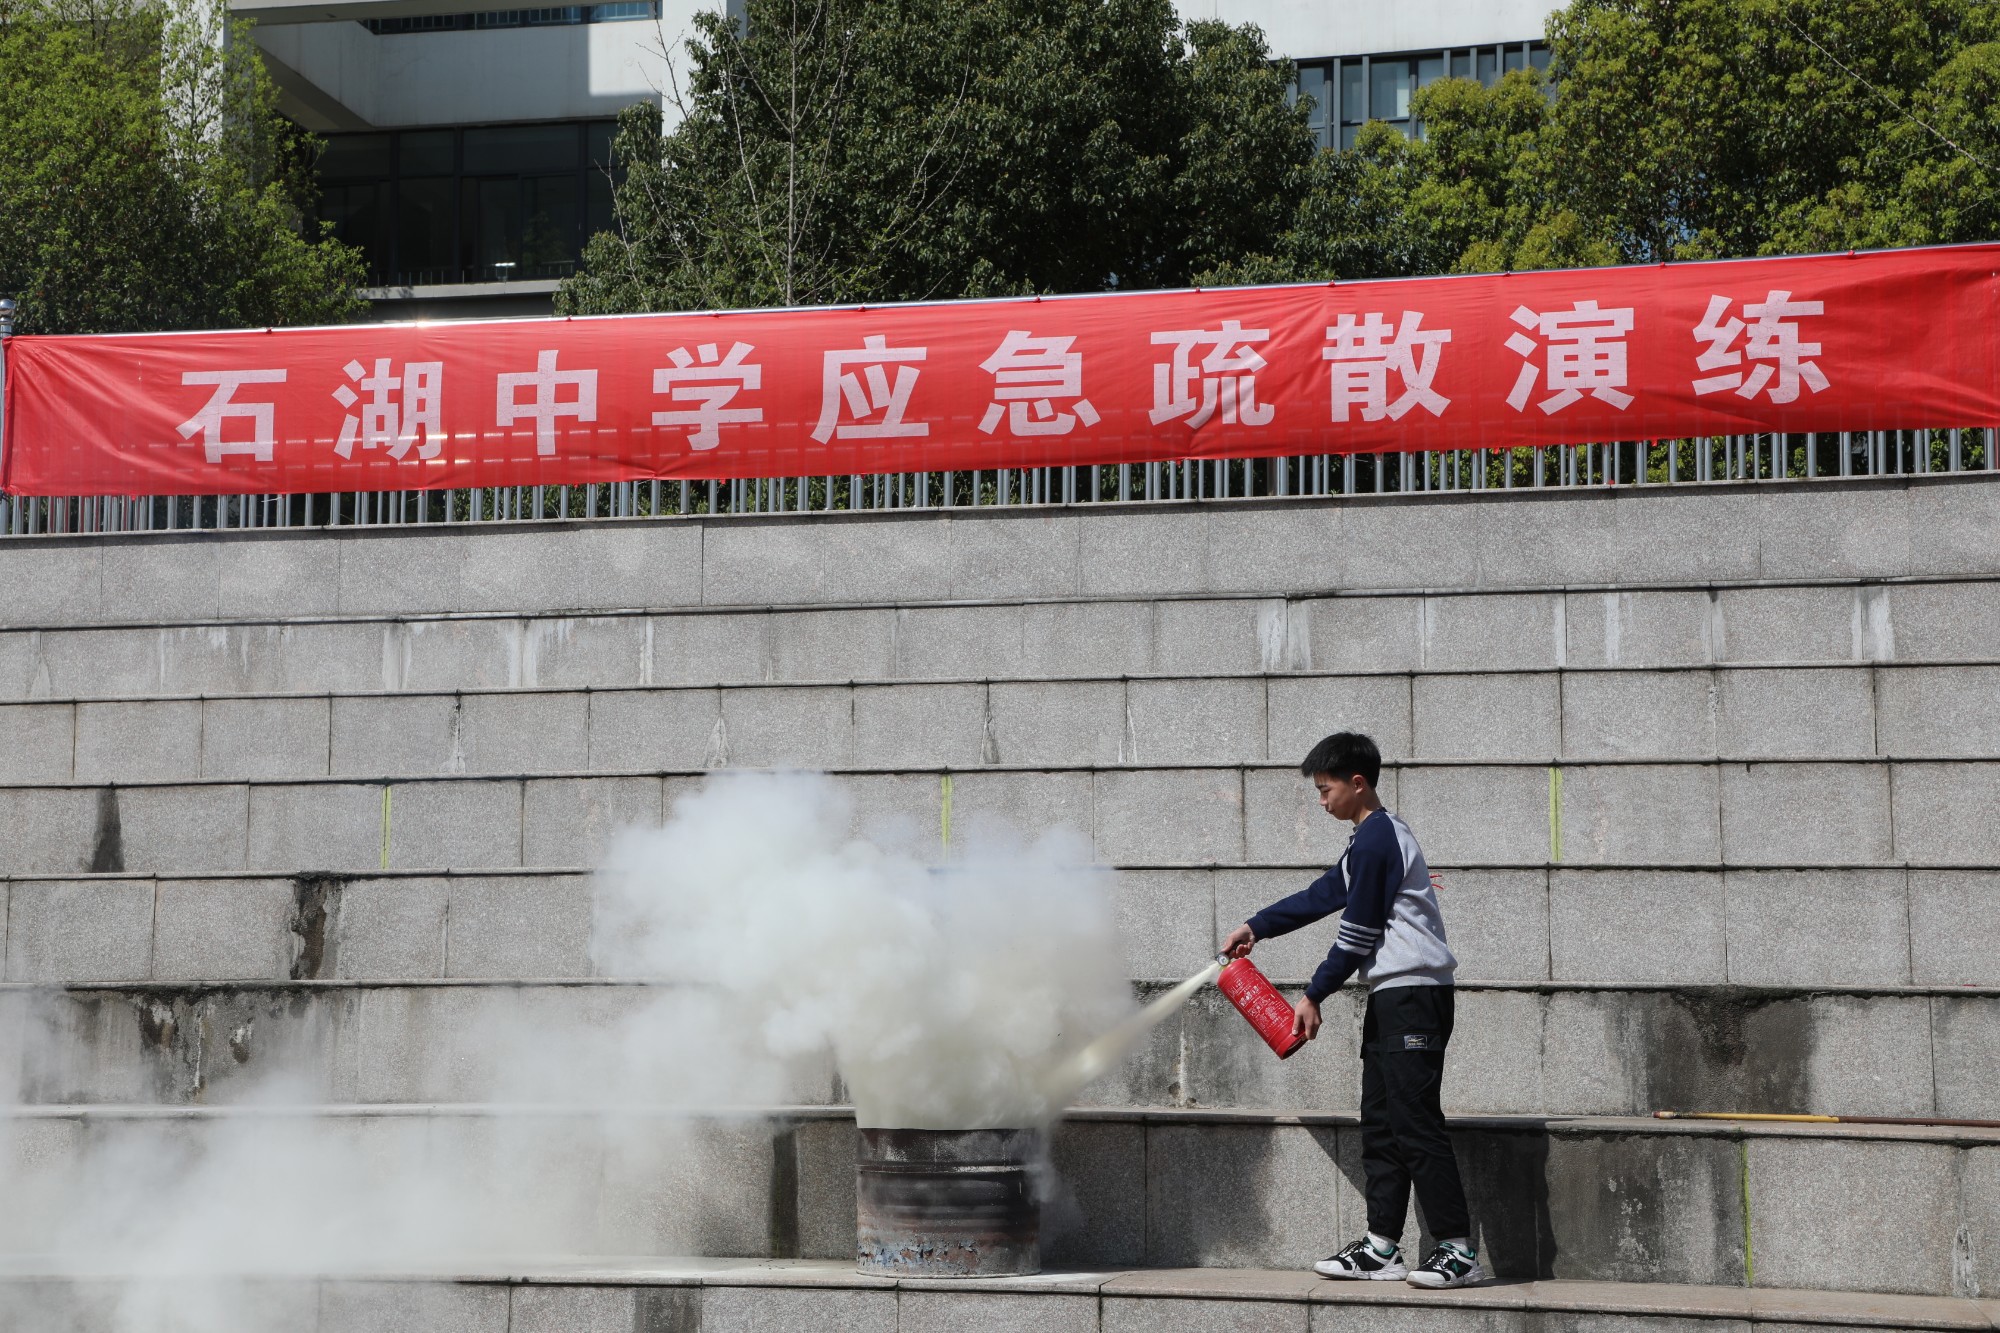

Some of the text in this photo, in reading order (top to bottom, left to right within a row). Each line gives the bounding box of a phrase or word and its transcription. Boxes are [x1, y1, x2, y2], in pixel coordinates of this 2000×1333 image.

[176, 290, 1830, 463] 石湖中学应急疏散演练
